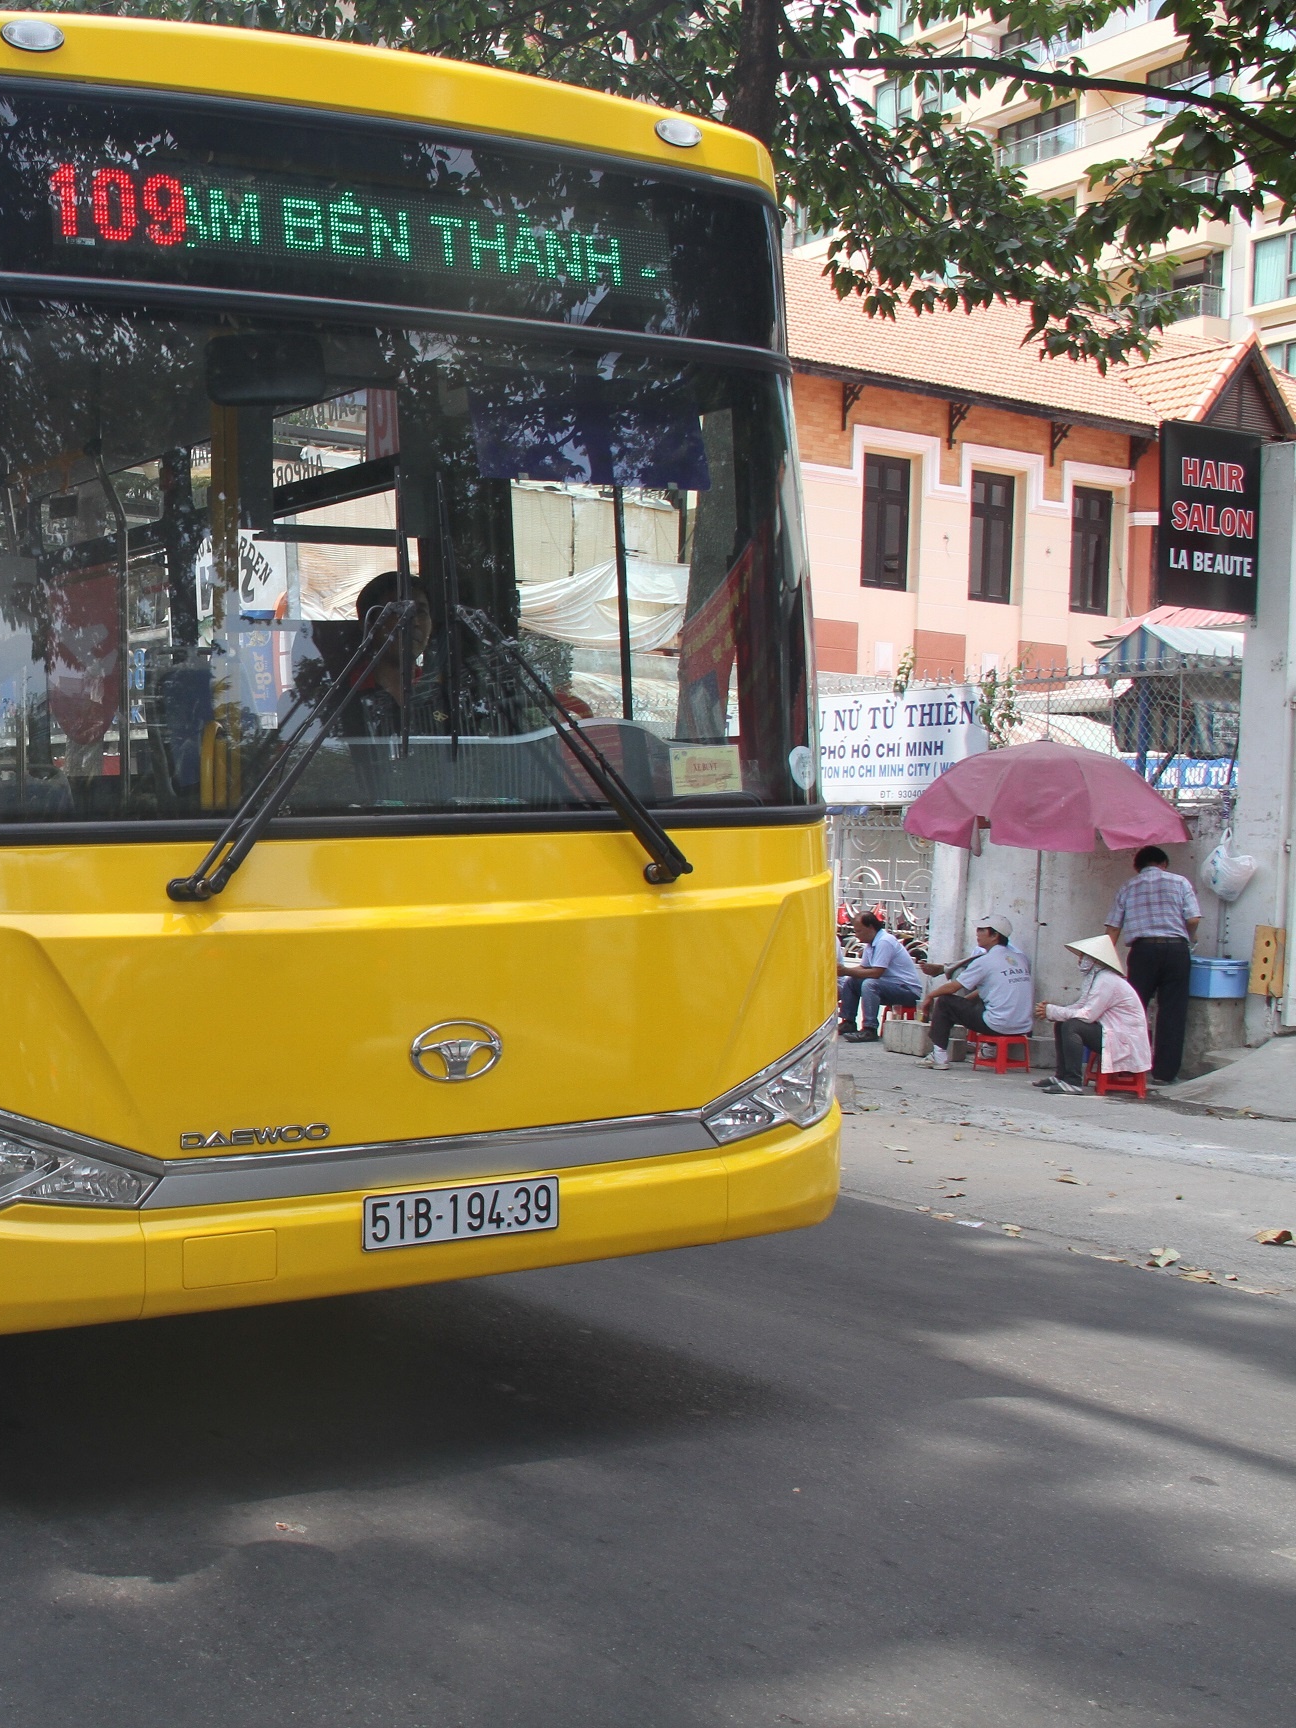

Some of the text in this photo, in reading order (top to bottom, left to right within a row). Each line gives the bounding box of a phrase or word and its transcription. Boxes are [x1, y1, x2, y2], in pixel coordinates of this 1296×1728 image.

[51, 163, 186, 245] 109
[430, 213, 622, 286] THÀNH
[1181, 456, 1245, 493] HAIR
[1171, 500, 1254, 539] SALON
[1169, 547, 1253, 577] LA BEAUTE
[253, 652, 272, 700] Tiger
[833, 700, 863, 732] NỮ
[868, 698, 898, 730] TỪ
[904, 693, 976, 733] THIỆN
[820, 735, 944, 760] PHỐ HỒ CHÍ MINH
[842, 764, 855, 779] HO
[858, 764, 875, 778] CHI
[878, 763, 904, 777] MINH
[907, 762, 931, 778] CITY
[180, 1122, 330, 1150] DAEWOO
[371, 1184, 552, 1243] 51B-194.39
